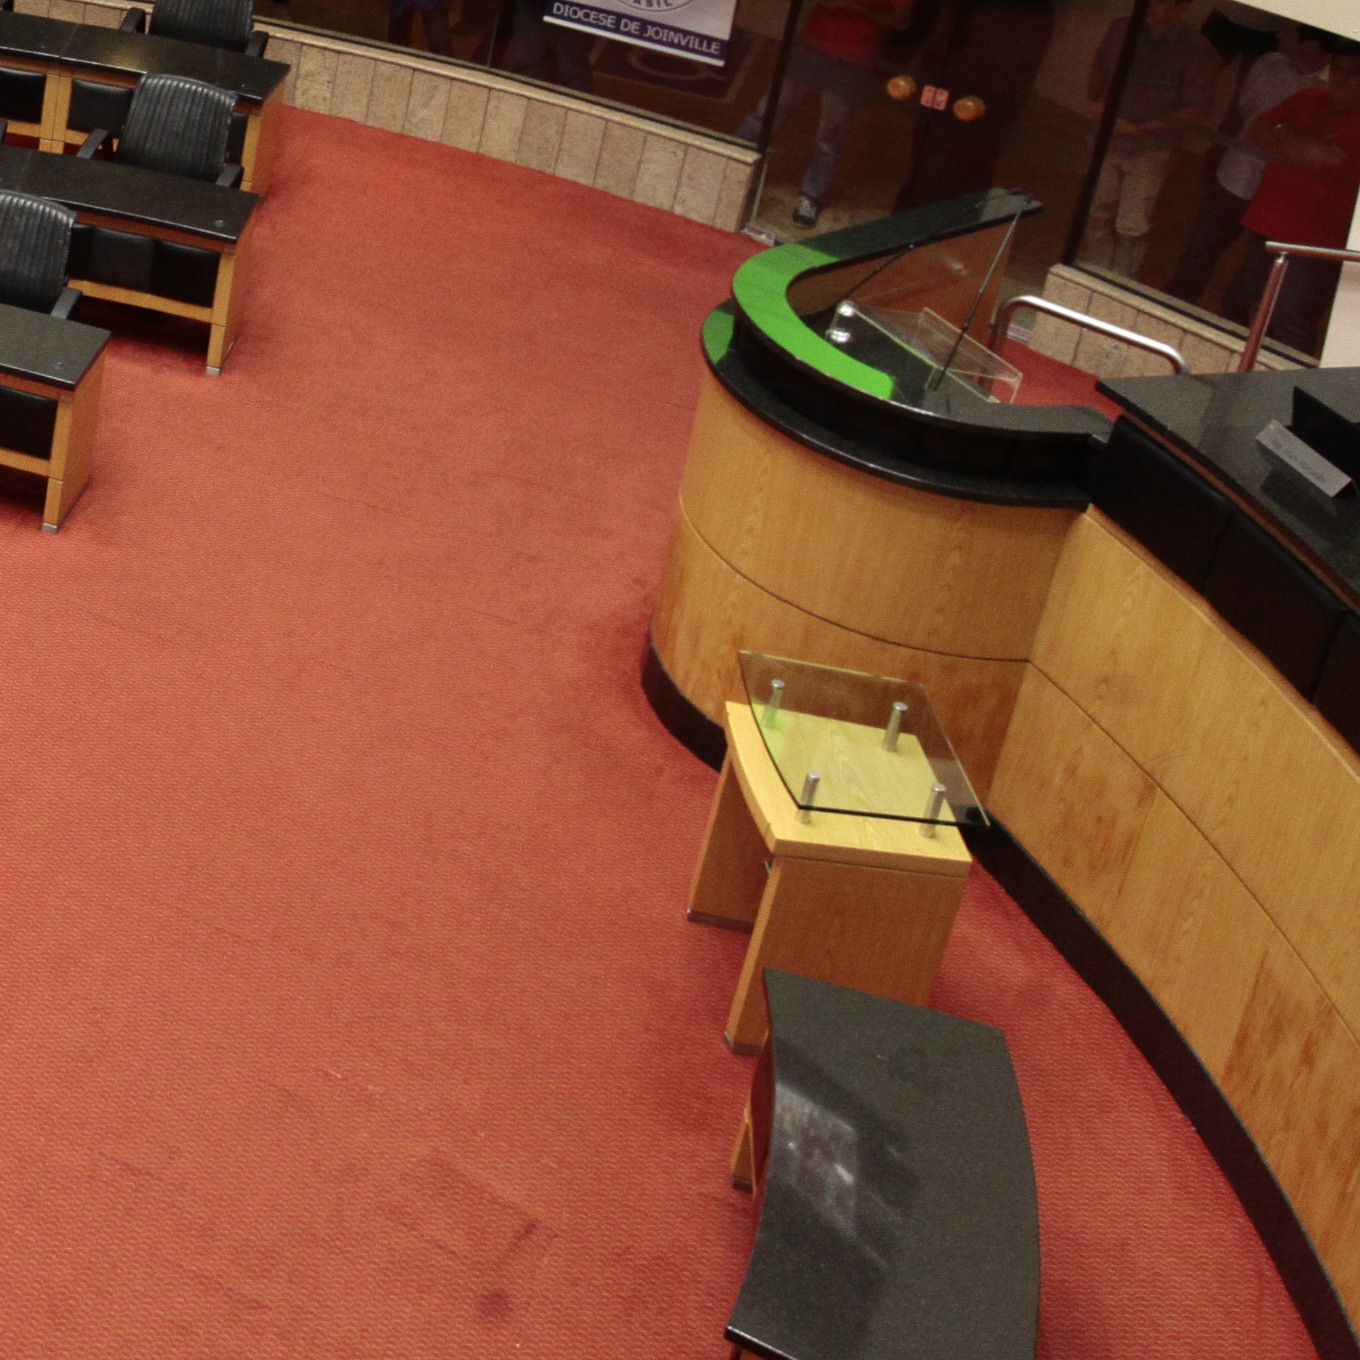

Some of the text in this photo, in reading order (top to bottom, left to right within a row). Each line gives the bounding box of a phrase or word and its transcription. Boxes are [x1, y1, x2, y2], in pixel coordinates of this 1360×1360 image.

[553, 2, 721, 55] DIOCESE DE JOINVILLE
